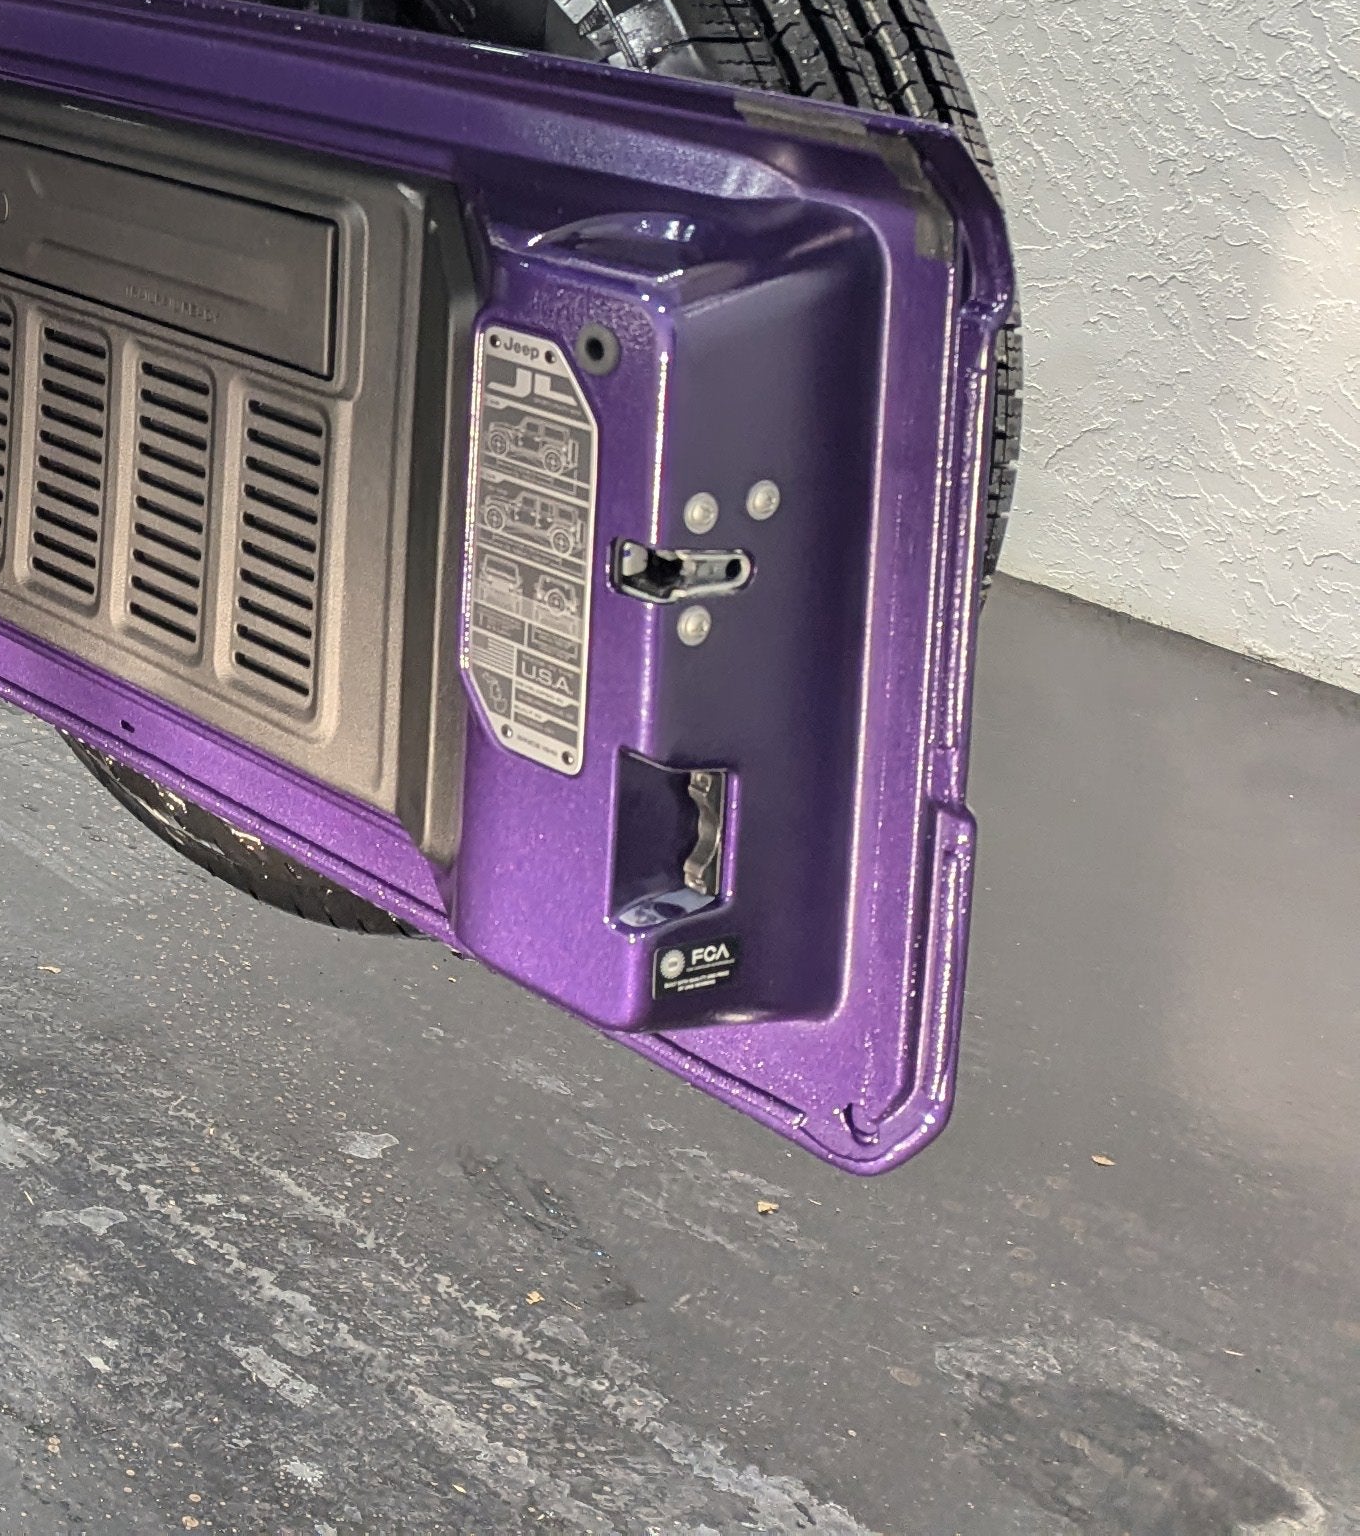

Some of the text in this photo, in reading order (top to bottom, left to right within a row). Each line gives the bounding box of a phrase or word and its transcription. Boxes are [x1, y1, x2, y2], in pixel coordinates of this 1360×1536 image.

[502, 337, 540, 361] Jeep
[487, 367, 579, 407] JL
[691, 942, 731, 966] FCA
